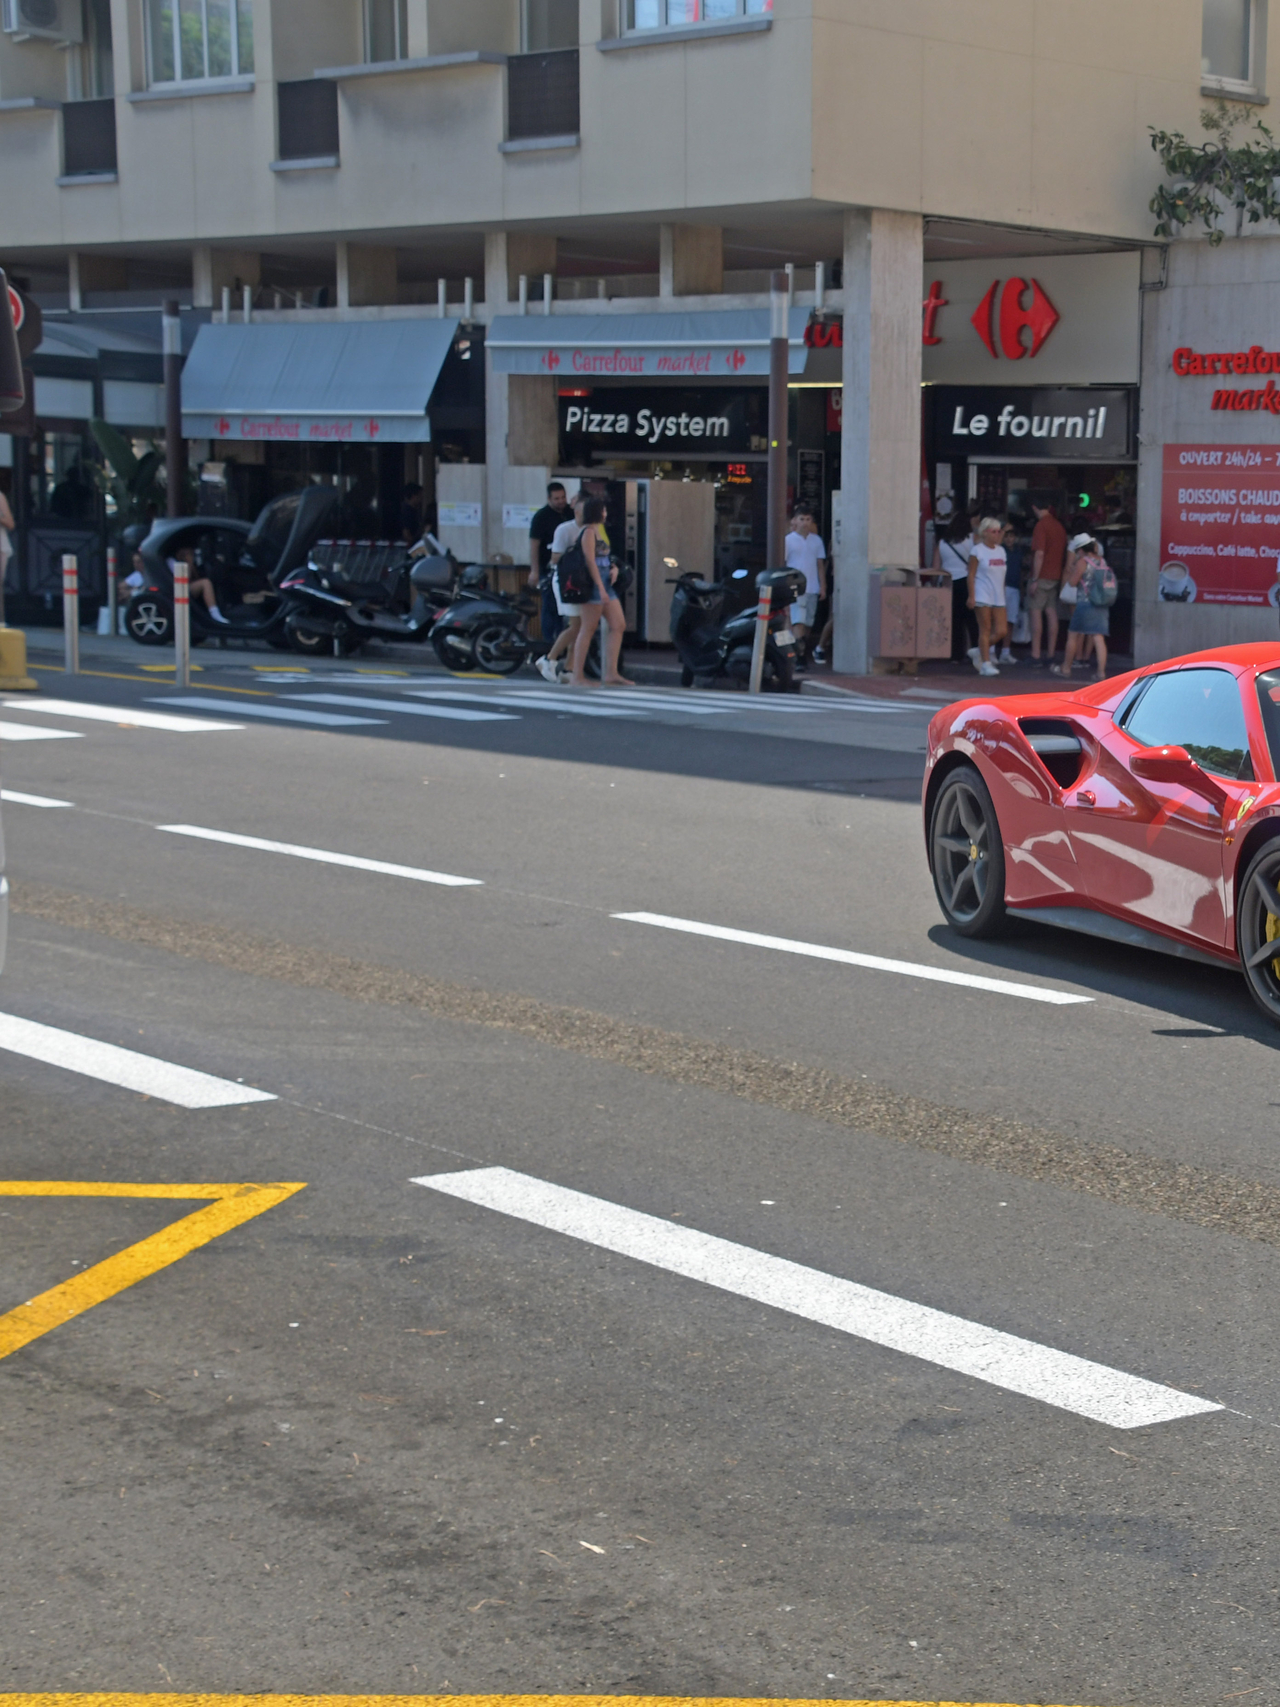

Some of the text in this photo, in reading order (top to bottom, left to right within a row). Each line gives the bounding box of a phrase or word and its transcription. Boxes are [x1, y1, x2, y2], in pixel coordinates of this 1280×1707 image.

[572, 349, 712, 375] Carrefour market
[240, 417, 353, 440] Carrefour market
[565, 406, 730, 443] Pizza System
[952, 405, 1107, 439] Le fournil
[1179, 451, 1223, 466] OUVERT
[1225, 450, 1262, 468] 24h/24
[1178, 488, 1237, 505] BOISSONS
[1188, 511, 1232, 526] emporter
[1240, 510, 1263, 524] take
[1168, 542, 1216, 557] Cappuccino,
[1217, 544, 1236, 557] Café
